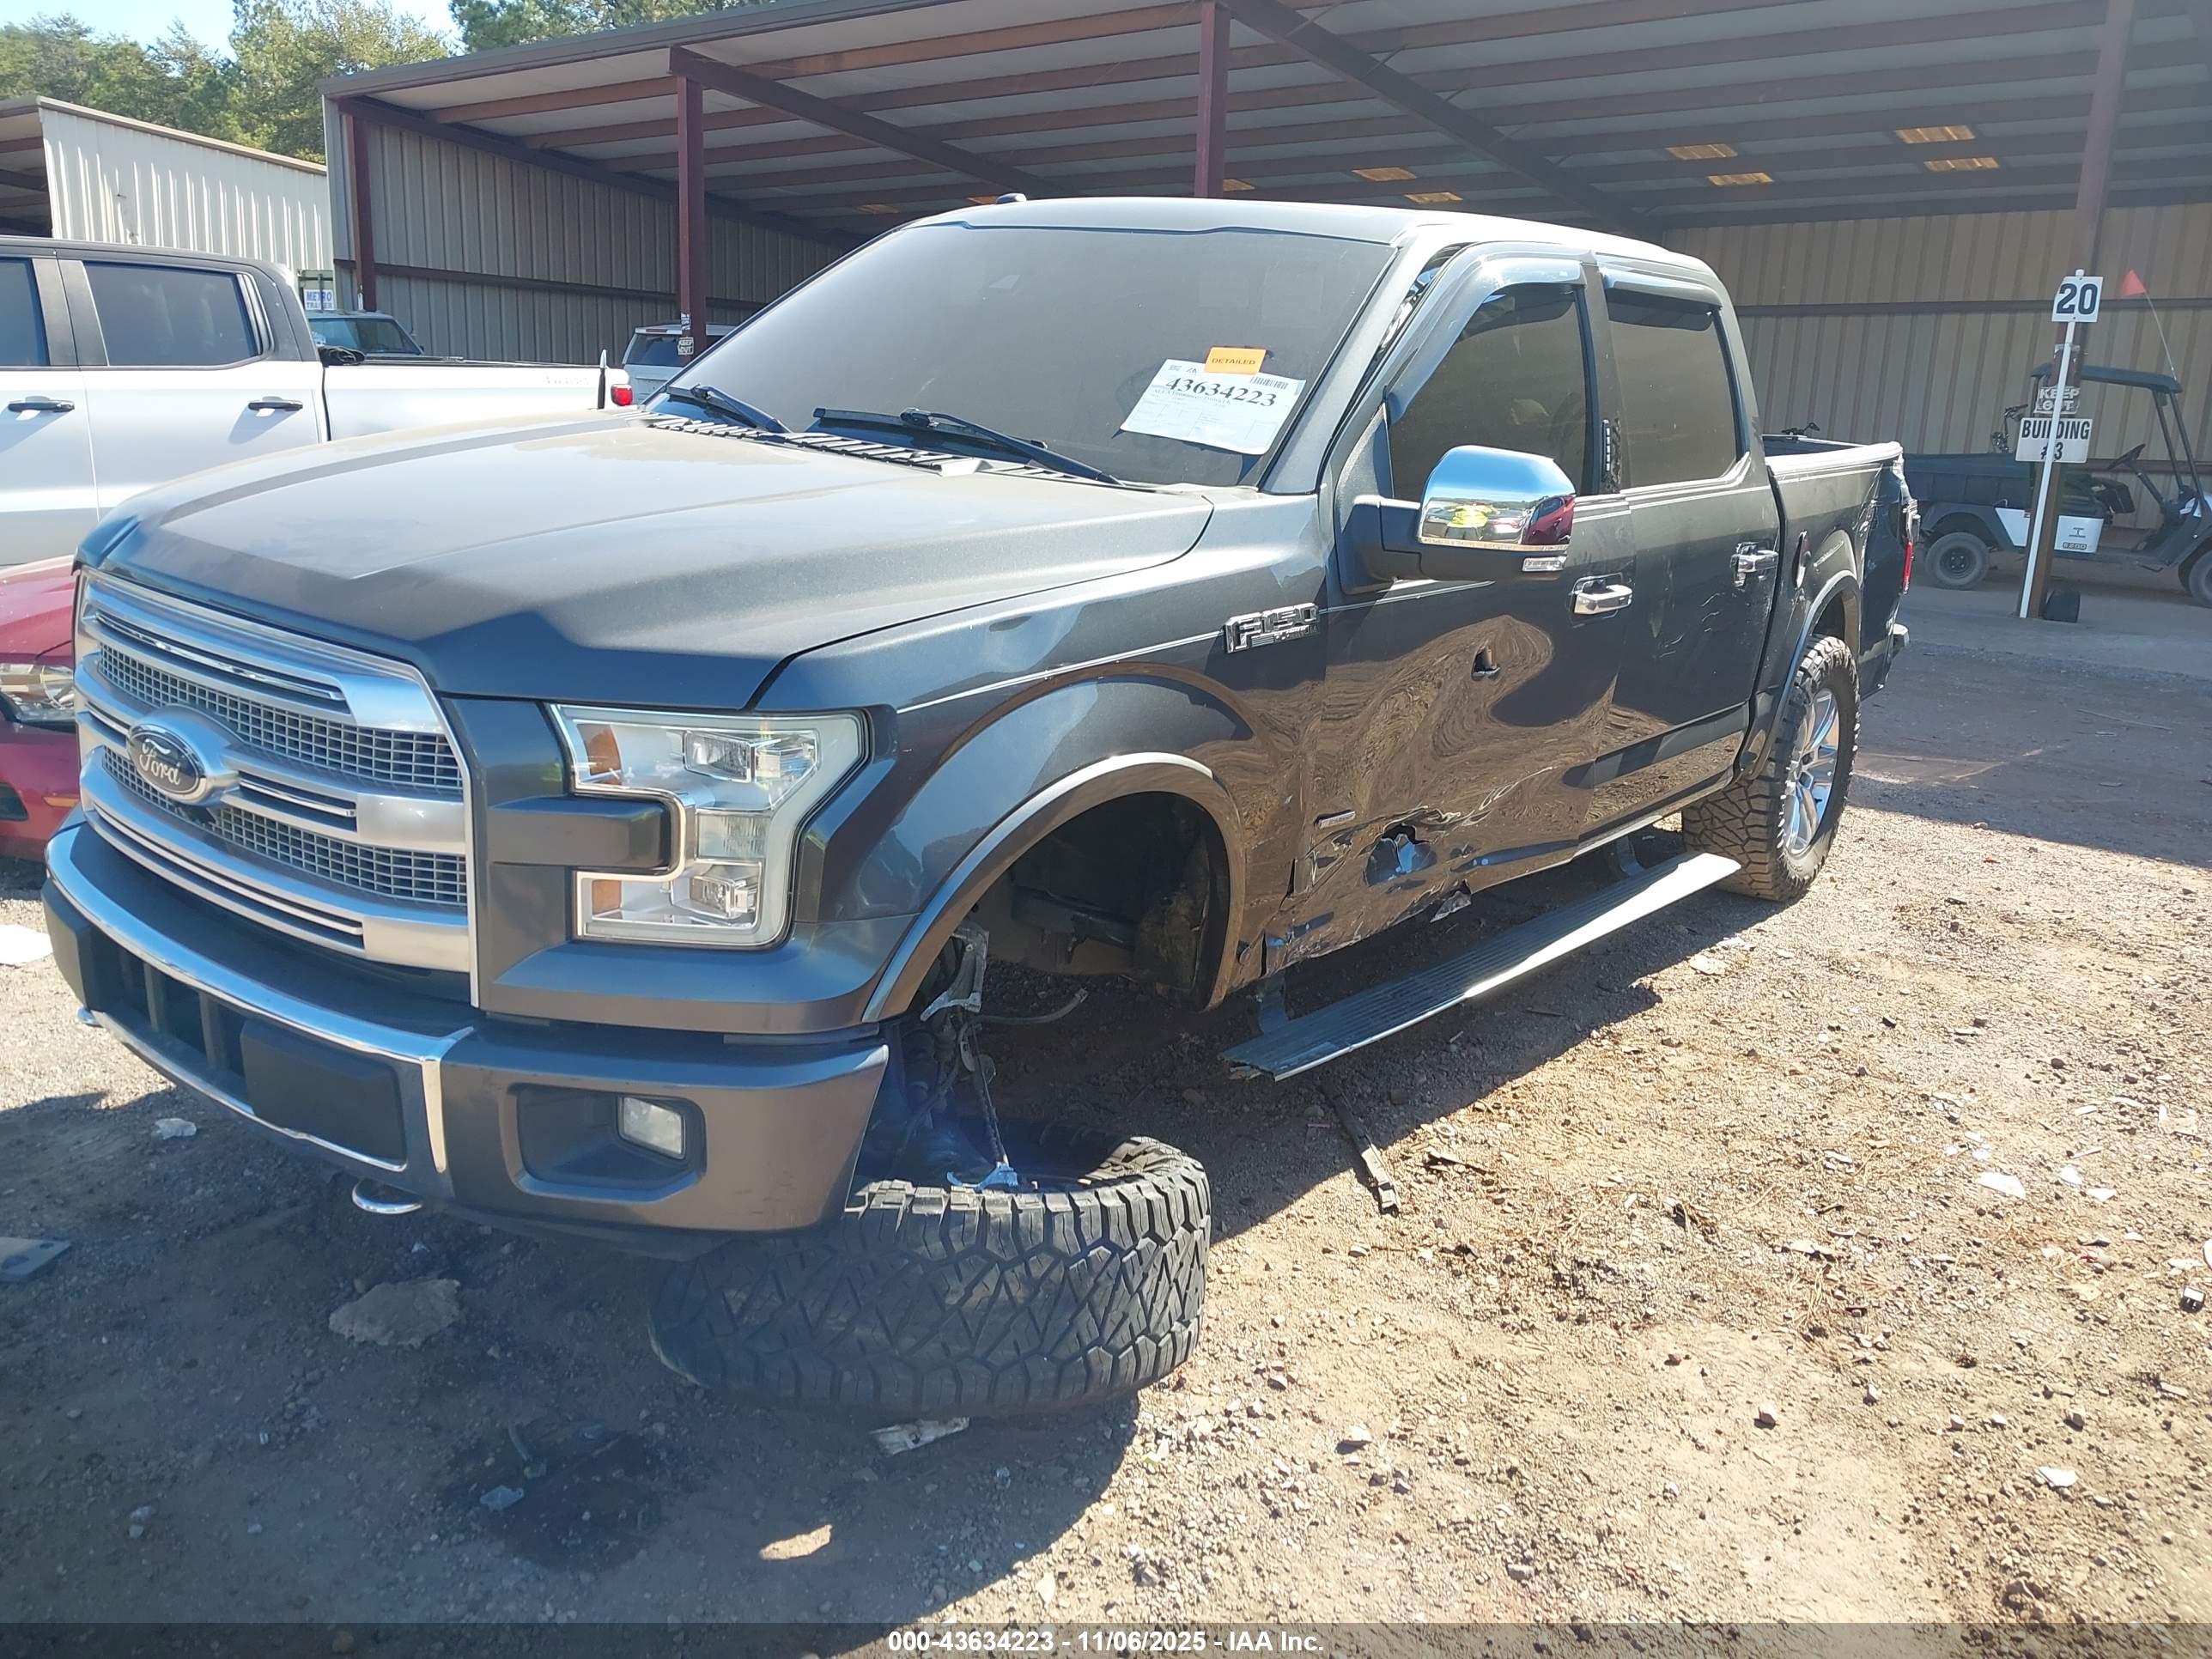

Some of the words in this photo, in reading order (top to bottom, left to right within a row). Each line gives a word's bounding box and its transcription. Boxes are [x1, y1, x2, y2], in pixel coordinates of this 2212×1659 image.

[2056, 283, 2098, 314] 20
[1165, 377, 1278, 407] 43634223
[2042, 400, 2074, 410] OT
[139, 738, 180, 785] Ford
